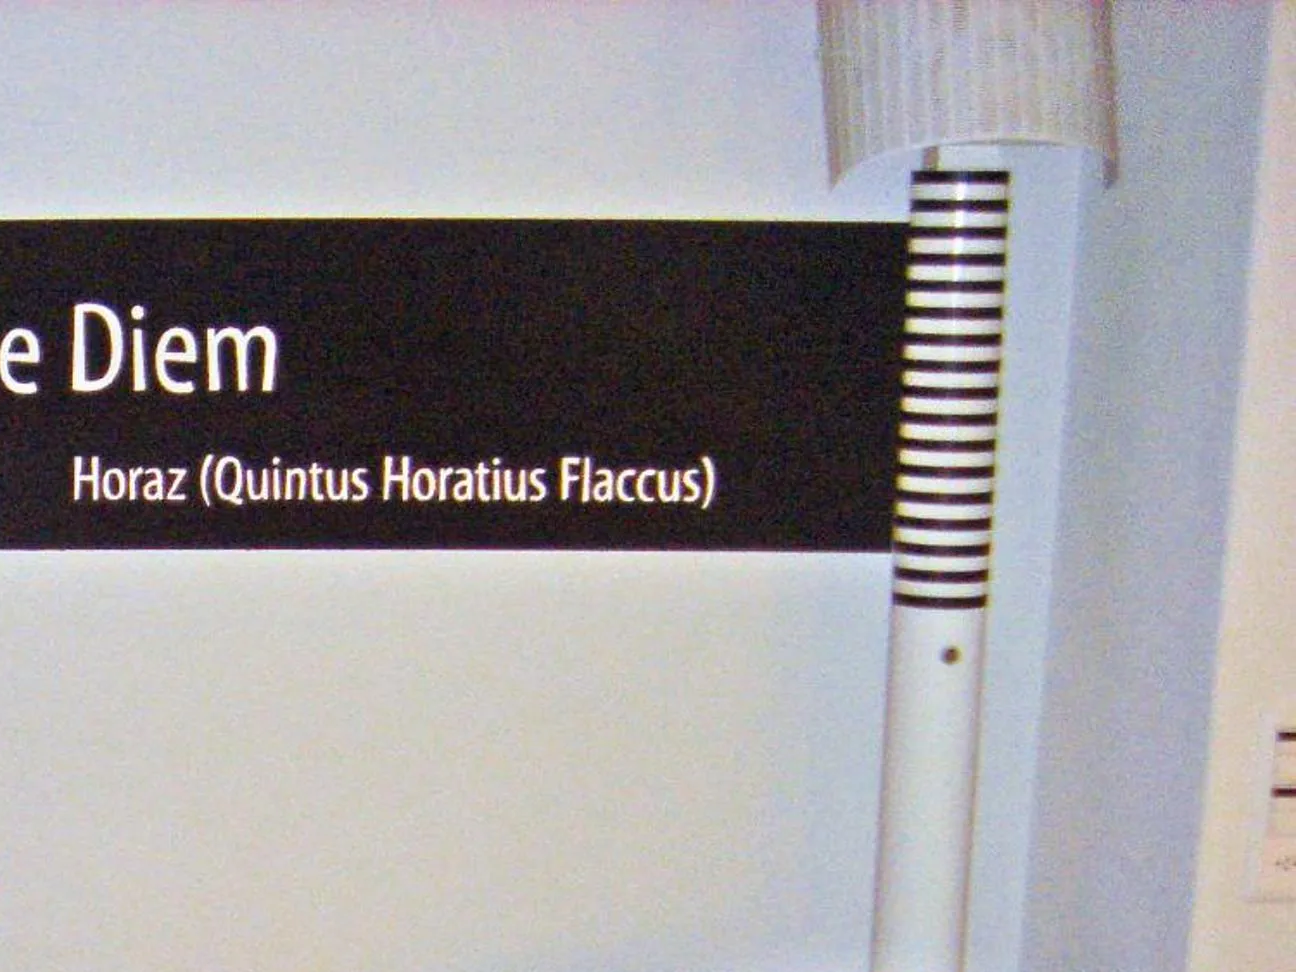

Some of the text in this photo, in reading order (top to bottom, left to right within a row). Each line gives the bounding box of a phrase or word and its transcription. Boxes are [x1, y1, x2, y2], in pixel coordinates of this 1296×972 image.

[70, 302, 279, 395] Diem
[71, 453, 717, 510] Horaz (Quintus Horatius Flaccus)
